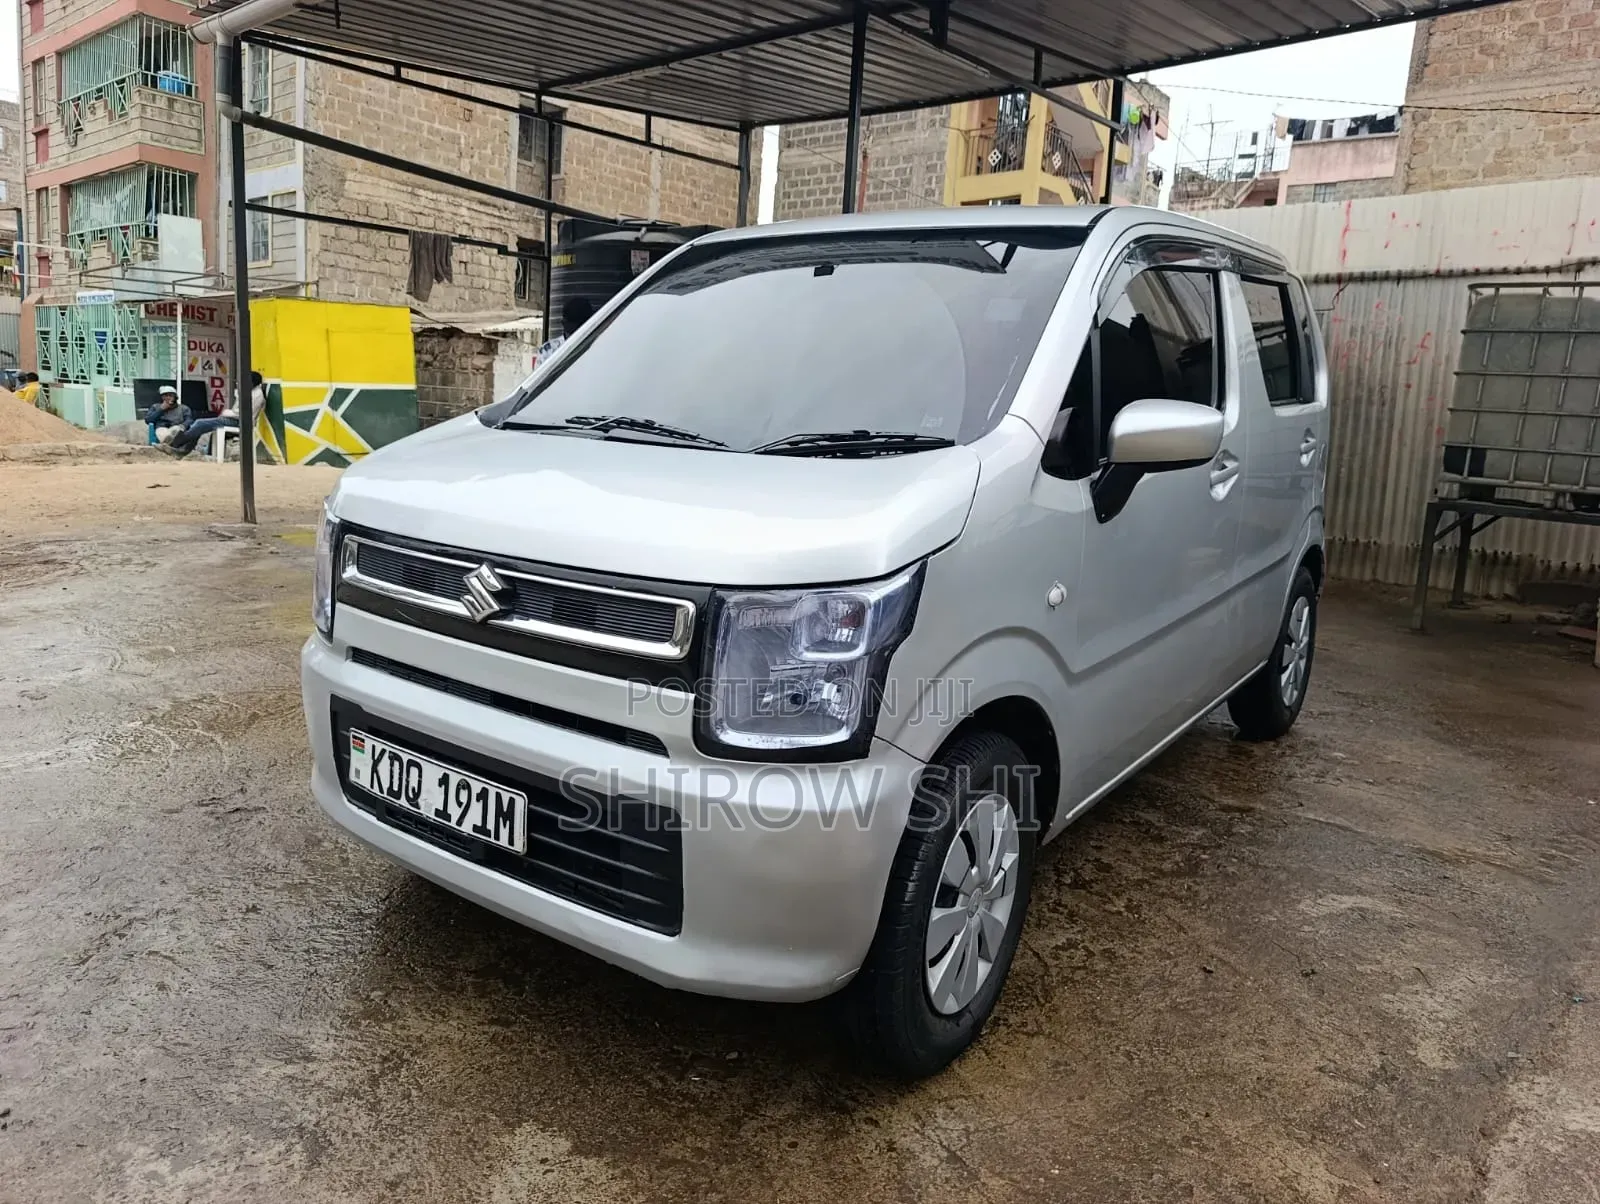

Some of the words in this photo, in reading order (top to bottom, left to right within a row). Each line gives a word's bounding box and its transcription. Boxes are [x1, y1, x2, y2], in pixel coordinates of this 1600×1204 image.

[144, 301, 218, 322] CHEMIST
[188, 340, 225, 354] DUKA
[369, 743, 423, 810] KDQ
[434, 771, 516, 847] 191M
